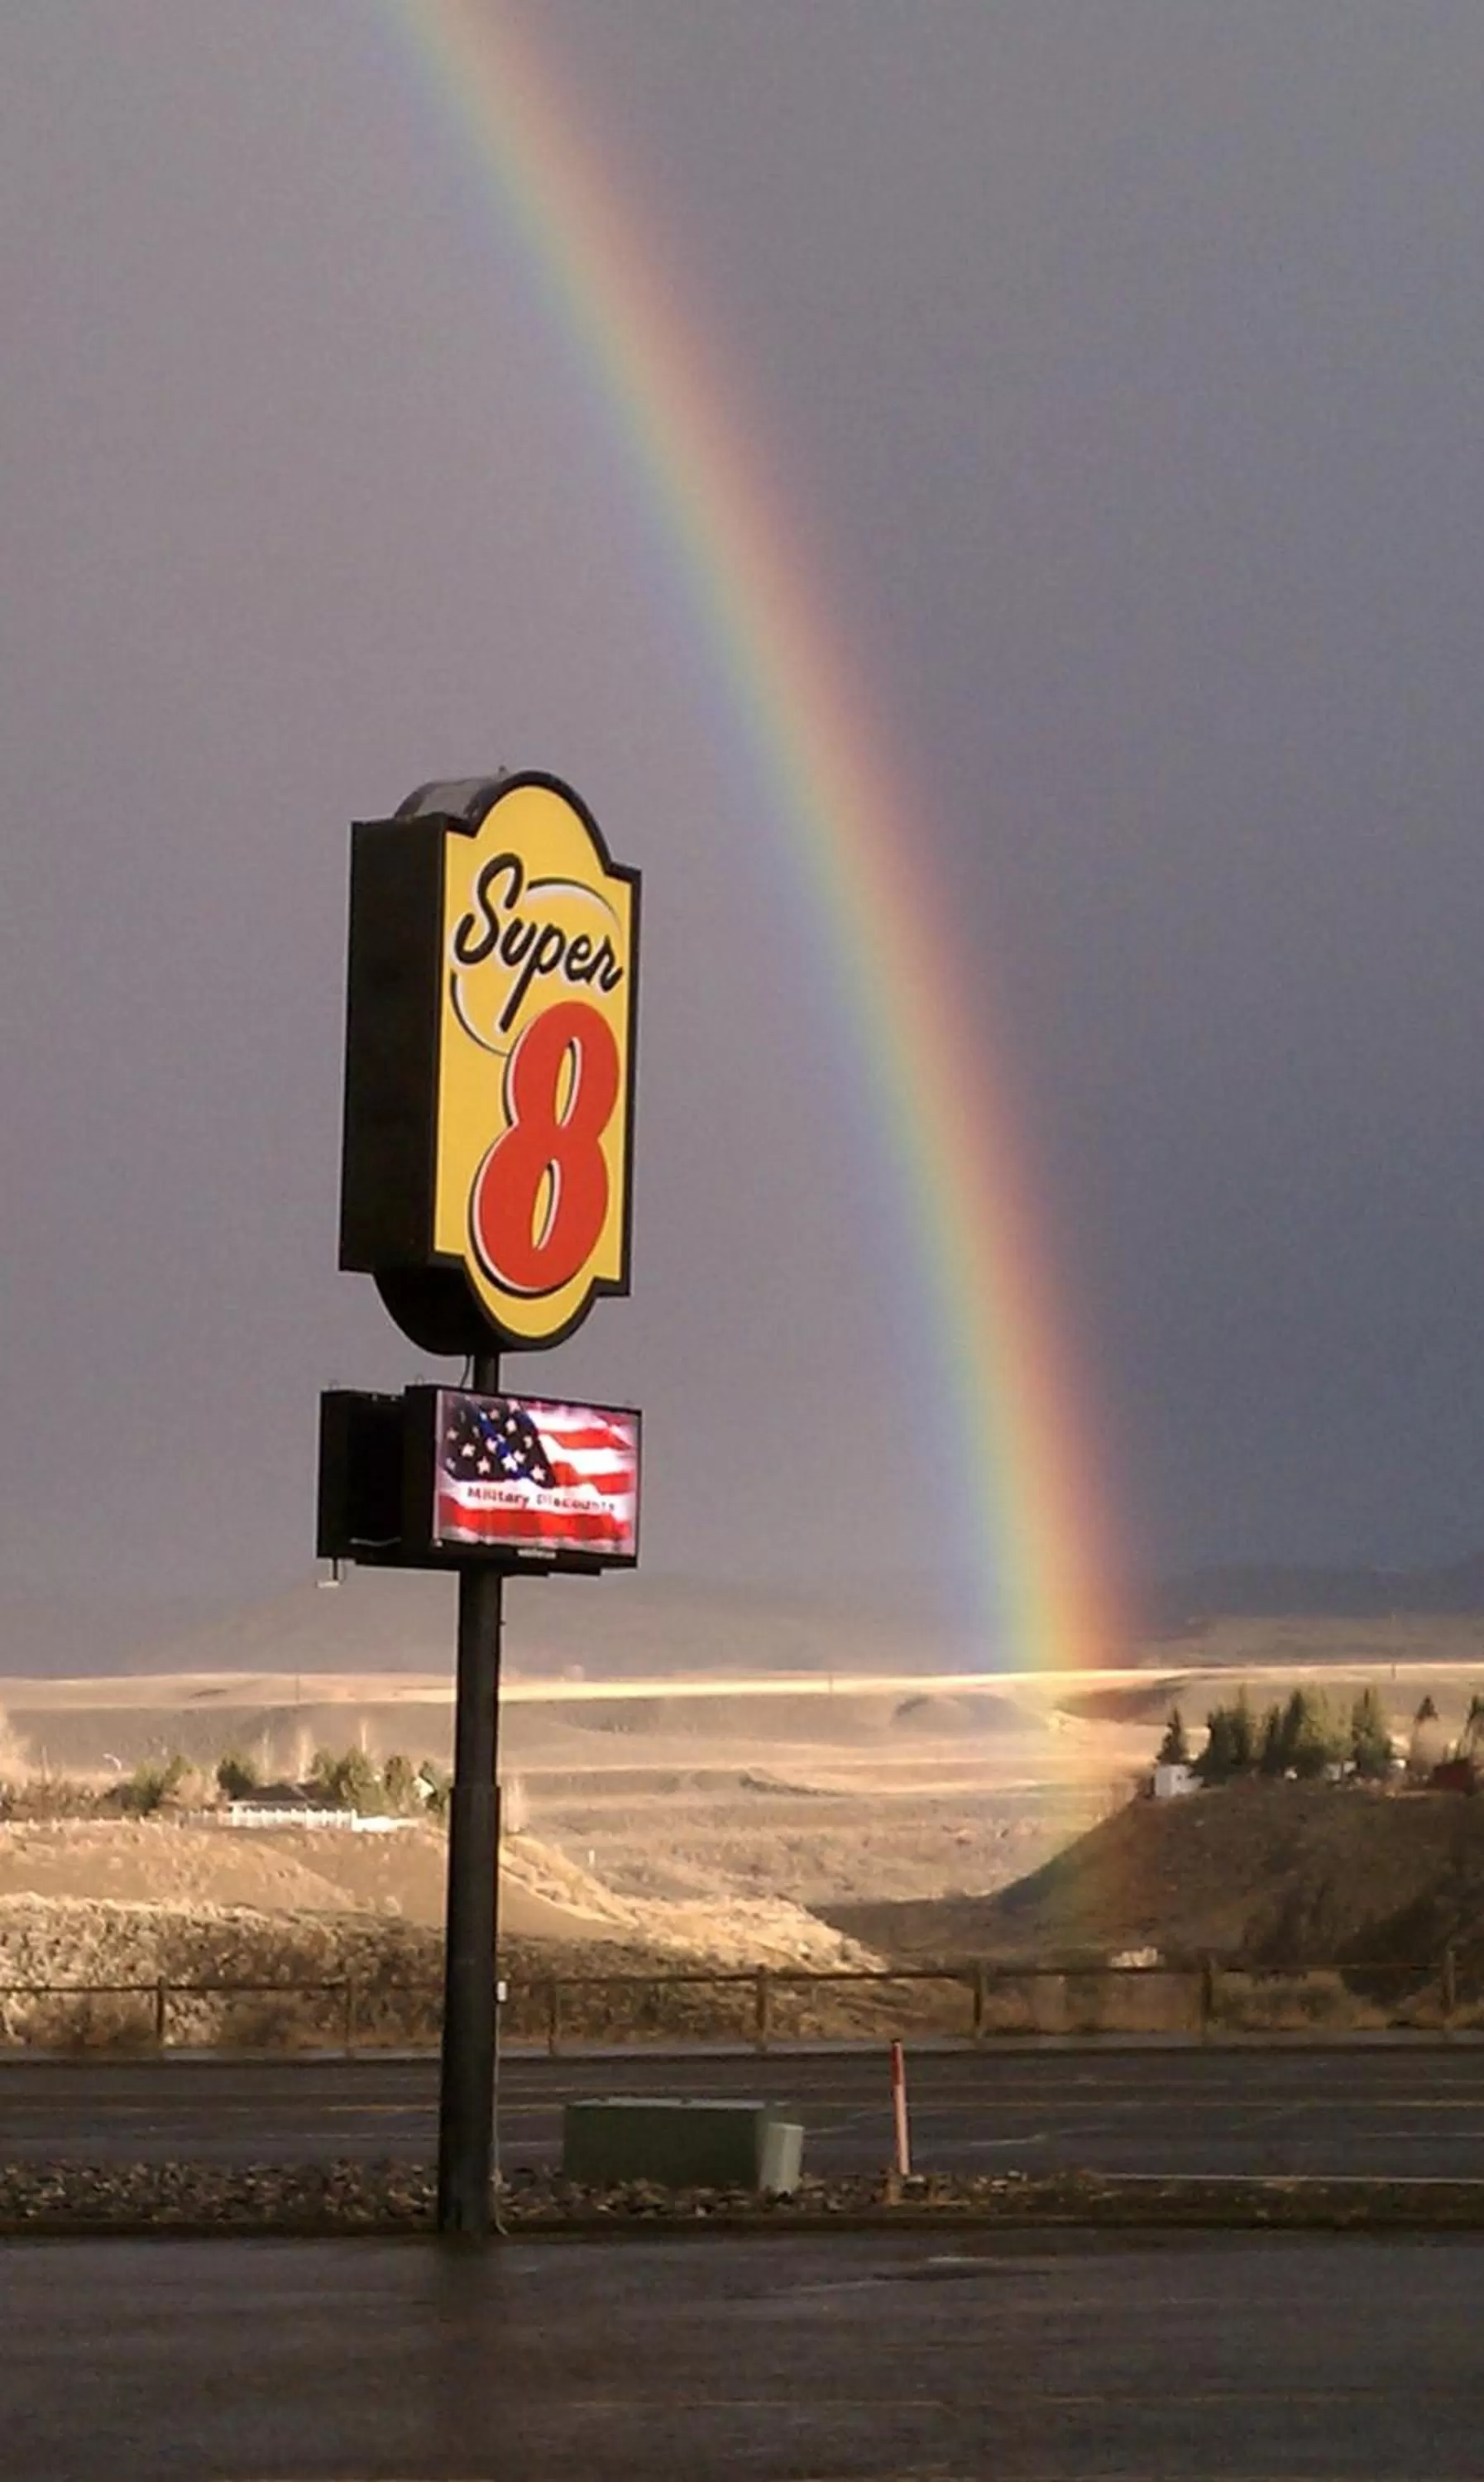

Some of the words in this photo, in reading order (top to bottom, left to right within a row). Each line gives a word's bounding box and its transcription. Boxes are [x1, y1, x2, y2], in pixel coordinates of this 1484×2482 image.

[453, 852, 623, 1033] Super
[469, 1001, 618, 1297] 8
[467, 1486, 530, 1509] Military
[536, 1493, 615, 1512] Discounts
